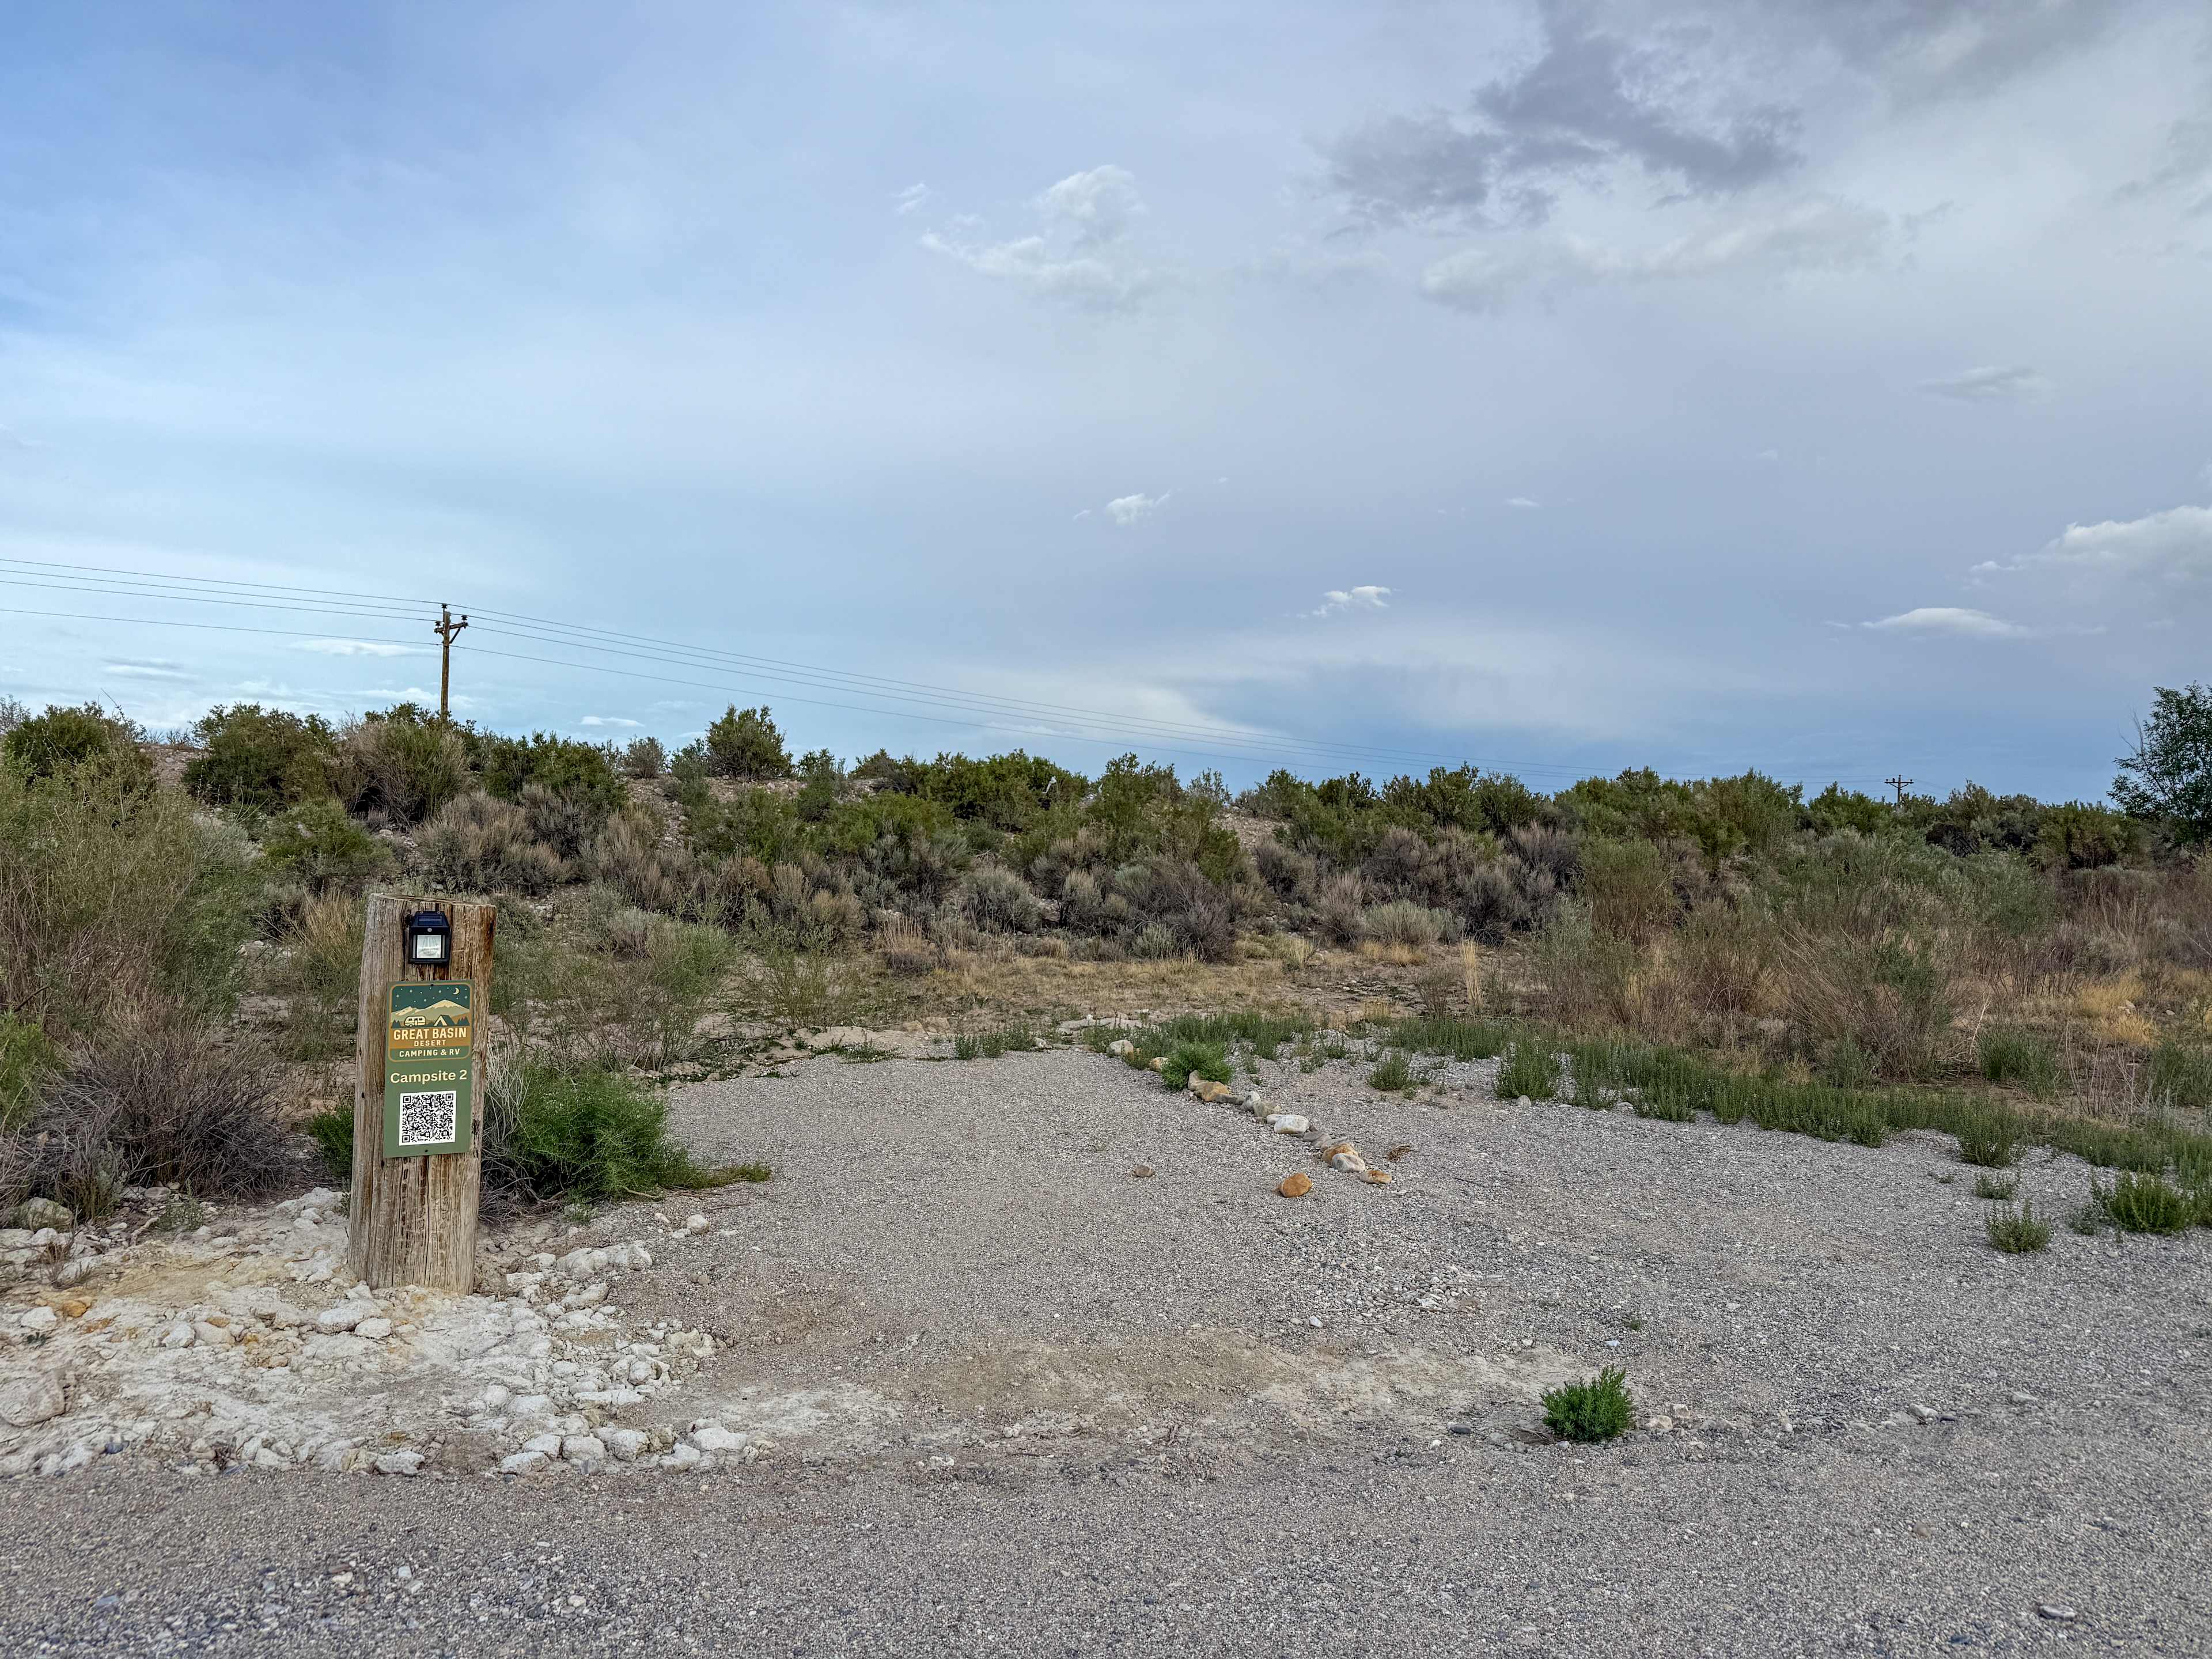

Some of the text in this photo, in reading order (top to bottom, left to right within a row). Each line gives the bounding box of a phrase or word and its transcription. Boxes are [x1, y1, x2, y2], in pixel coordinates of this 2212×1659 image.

[393, 1027, 467, 1040] GREAT BASIN
[399, 1049, 438, 1057] CAMPING
[390, 1070, 467, 1084] Campsite 2
